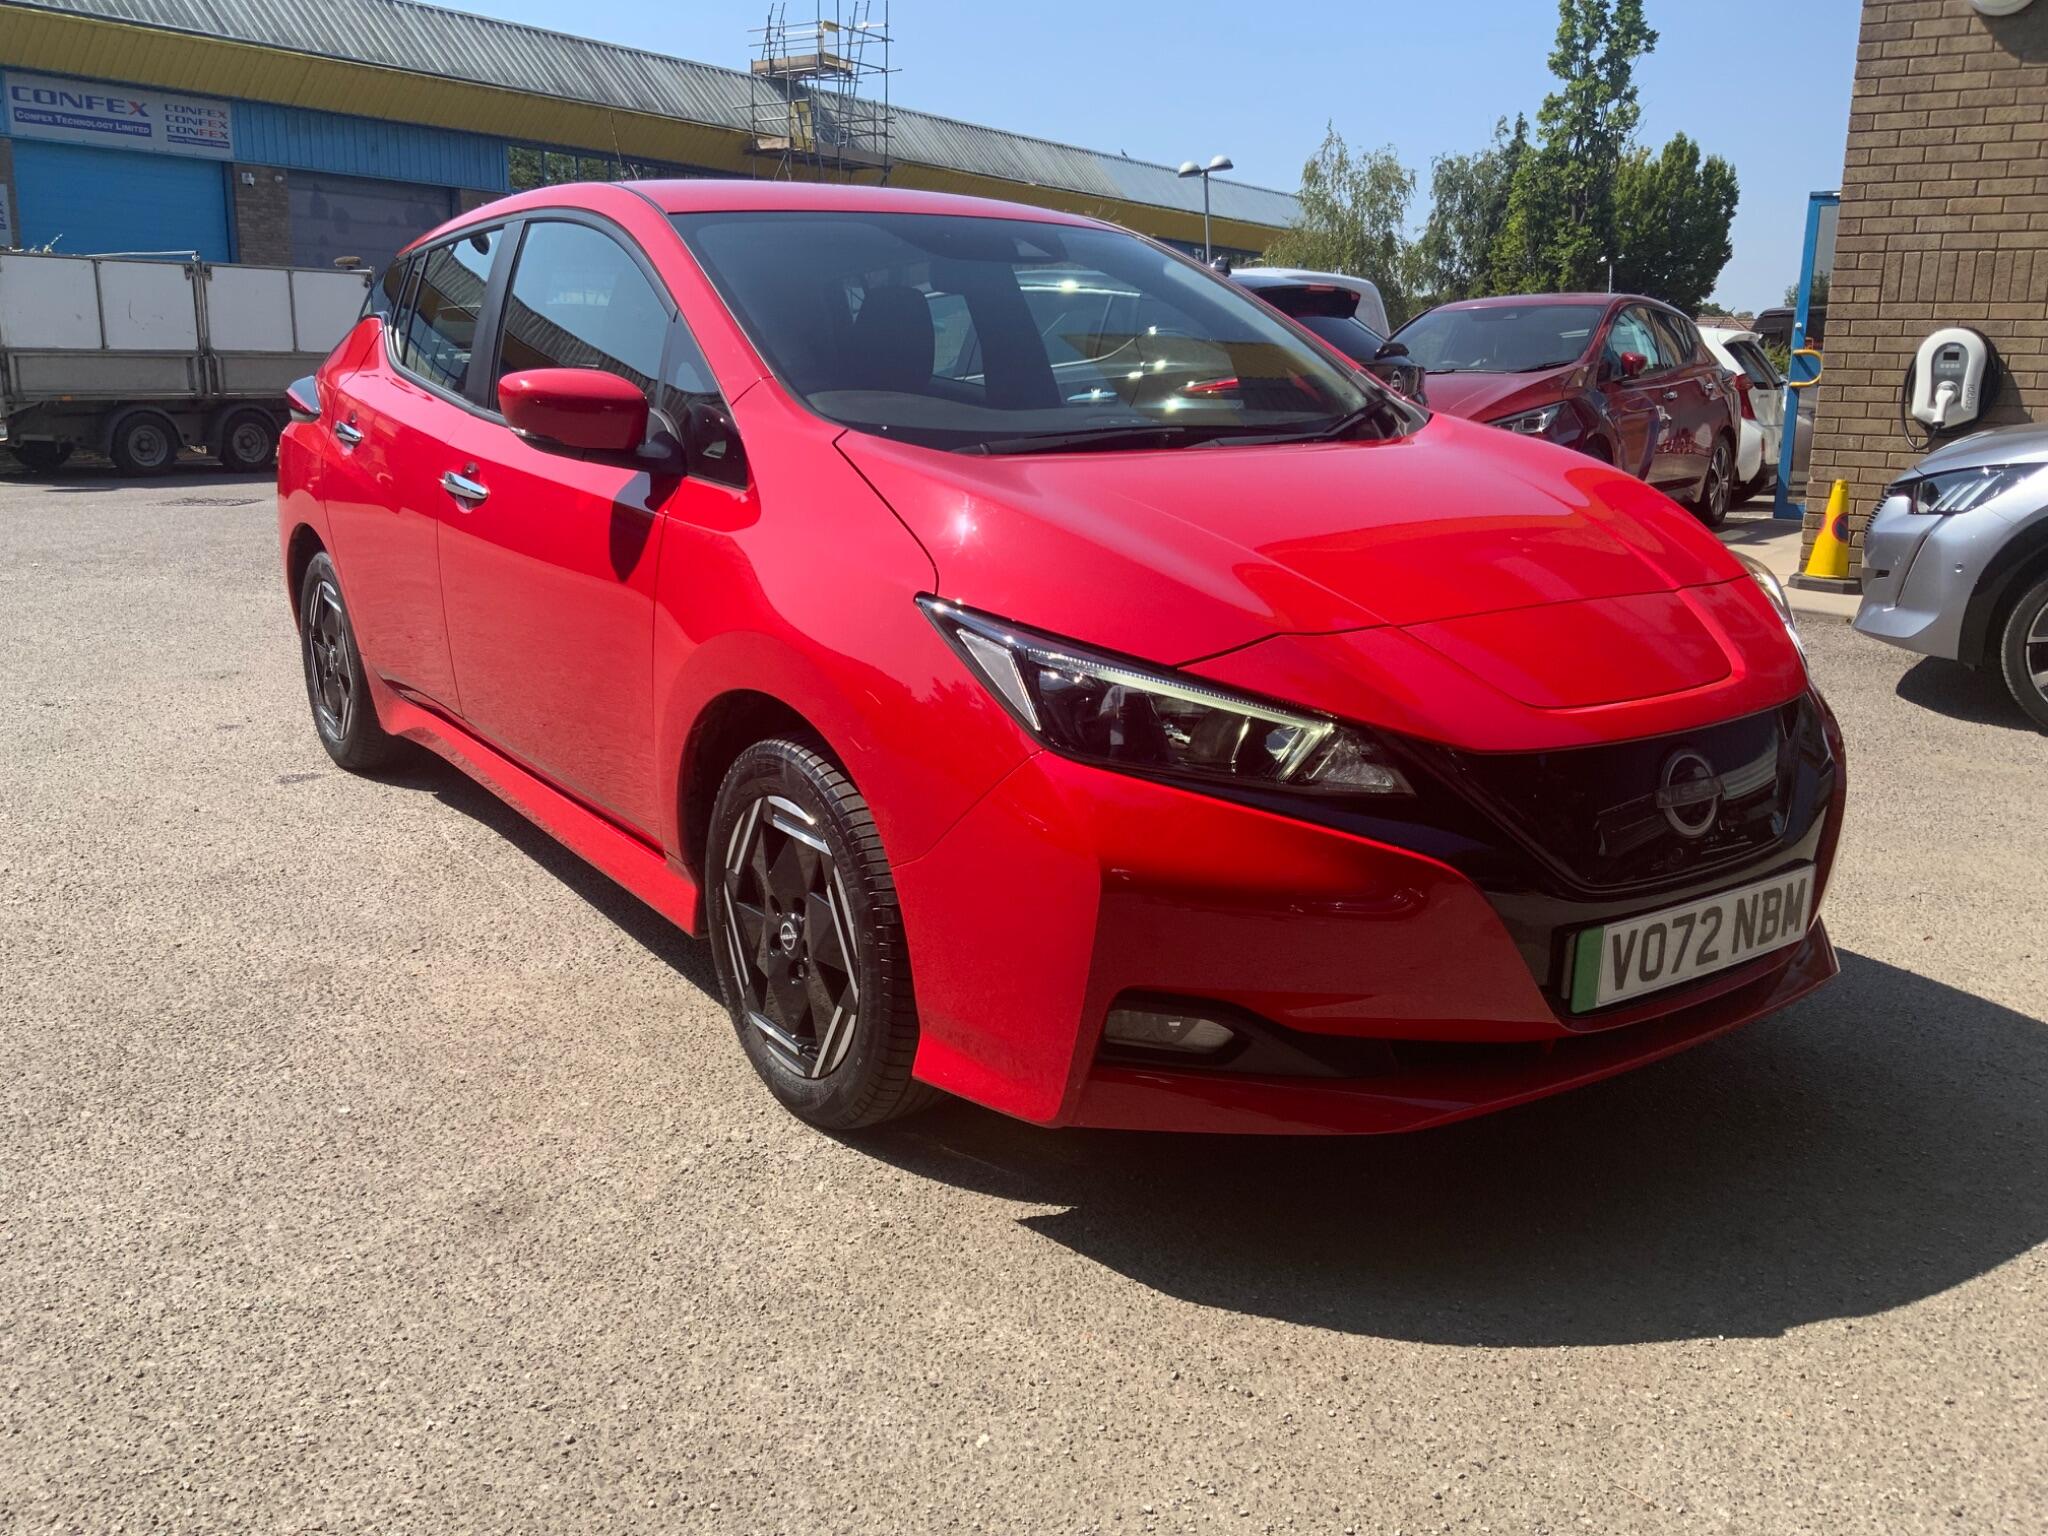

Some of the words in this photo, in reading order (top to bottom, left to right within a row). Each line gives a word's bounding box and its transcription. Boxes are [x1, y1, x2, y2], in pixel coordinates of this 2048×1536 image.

[11, 86, 149, 117] CONFEX
[165, 104, 227, 119] CONFEX
[16, 111, 53, 123] CONFEX
[55, 115, 114, 130] TECHNOLOGY
[116, 123, 150, 135] LIMITED
[165, 114, 228, 129] CONFEX
[166, 124, 229, 139] CONFEX
[1612, 906, 1723, 991] VO72
[1732, 878, 1807, 954] NBM
